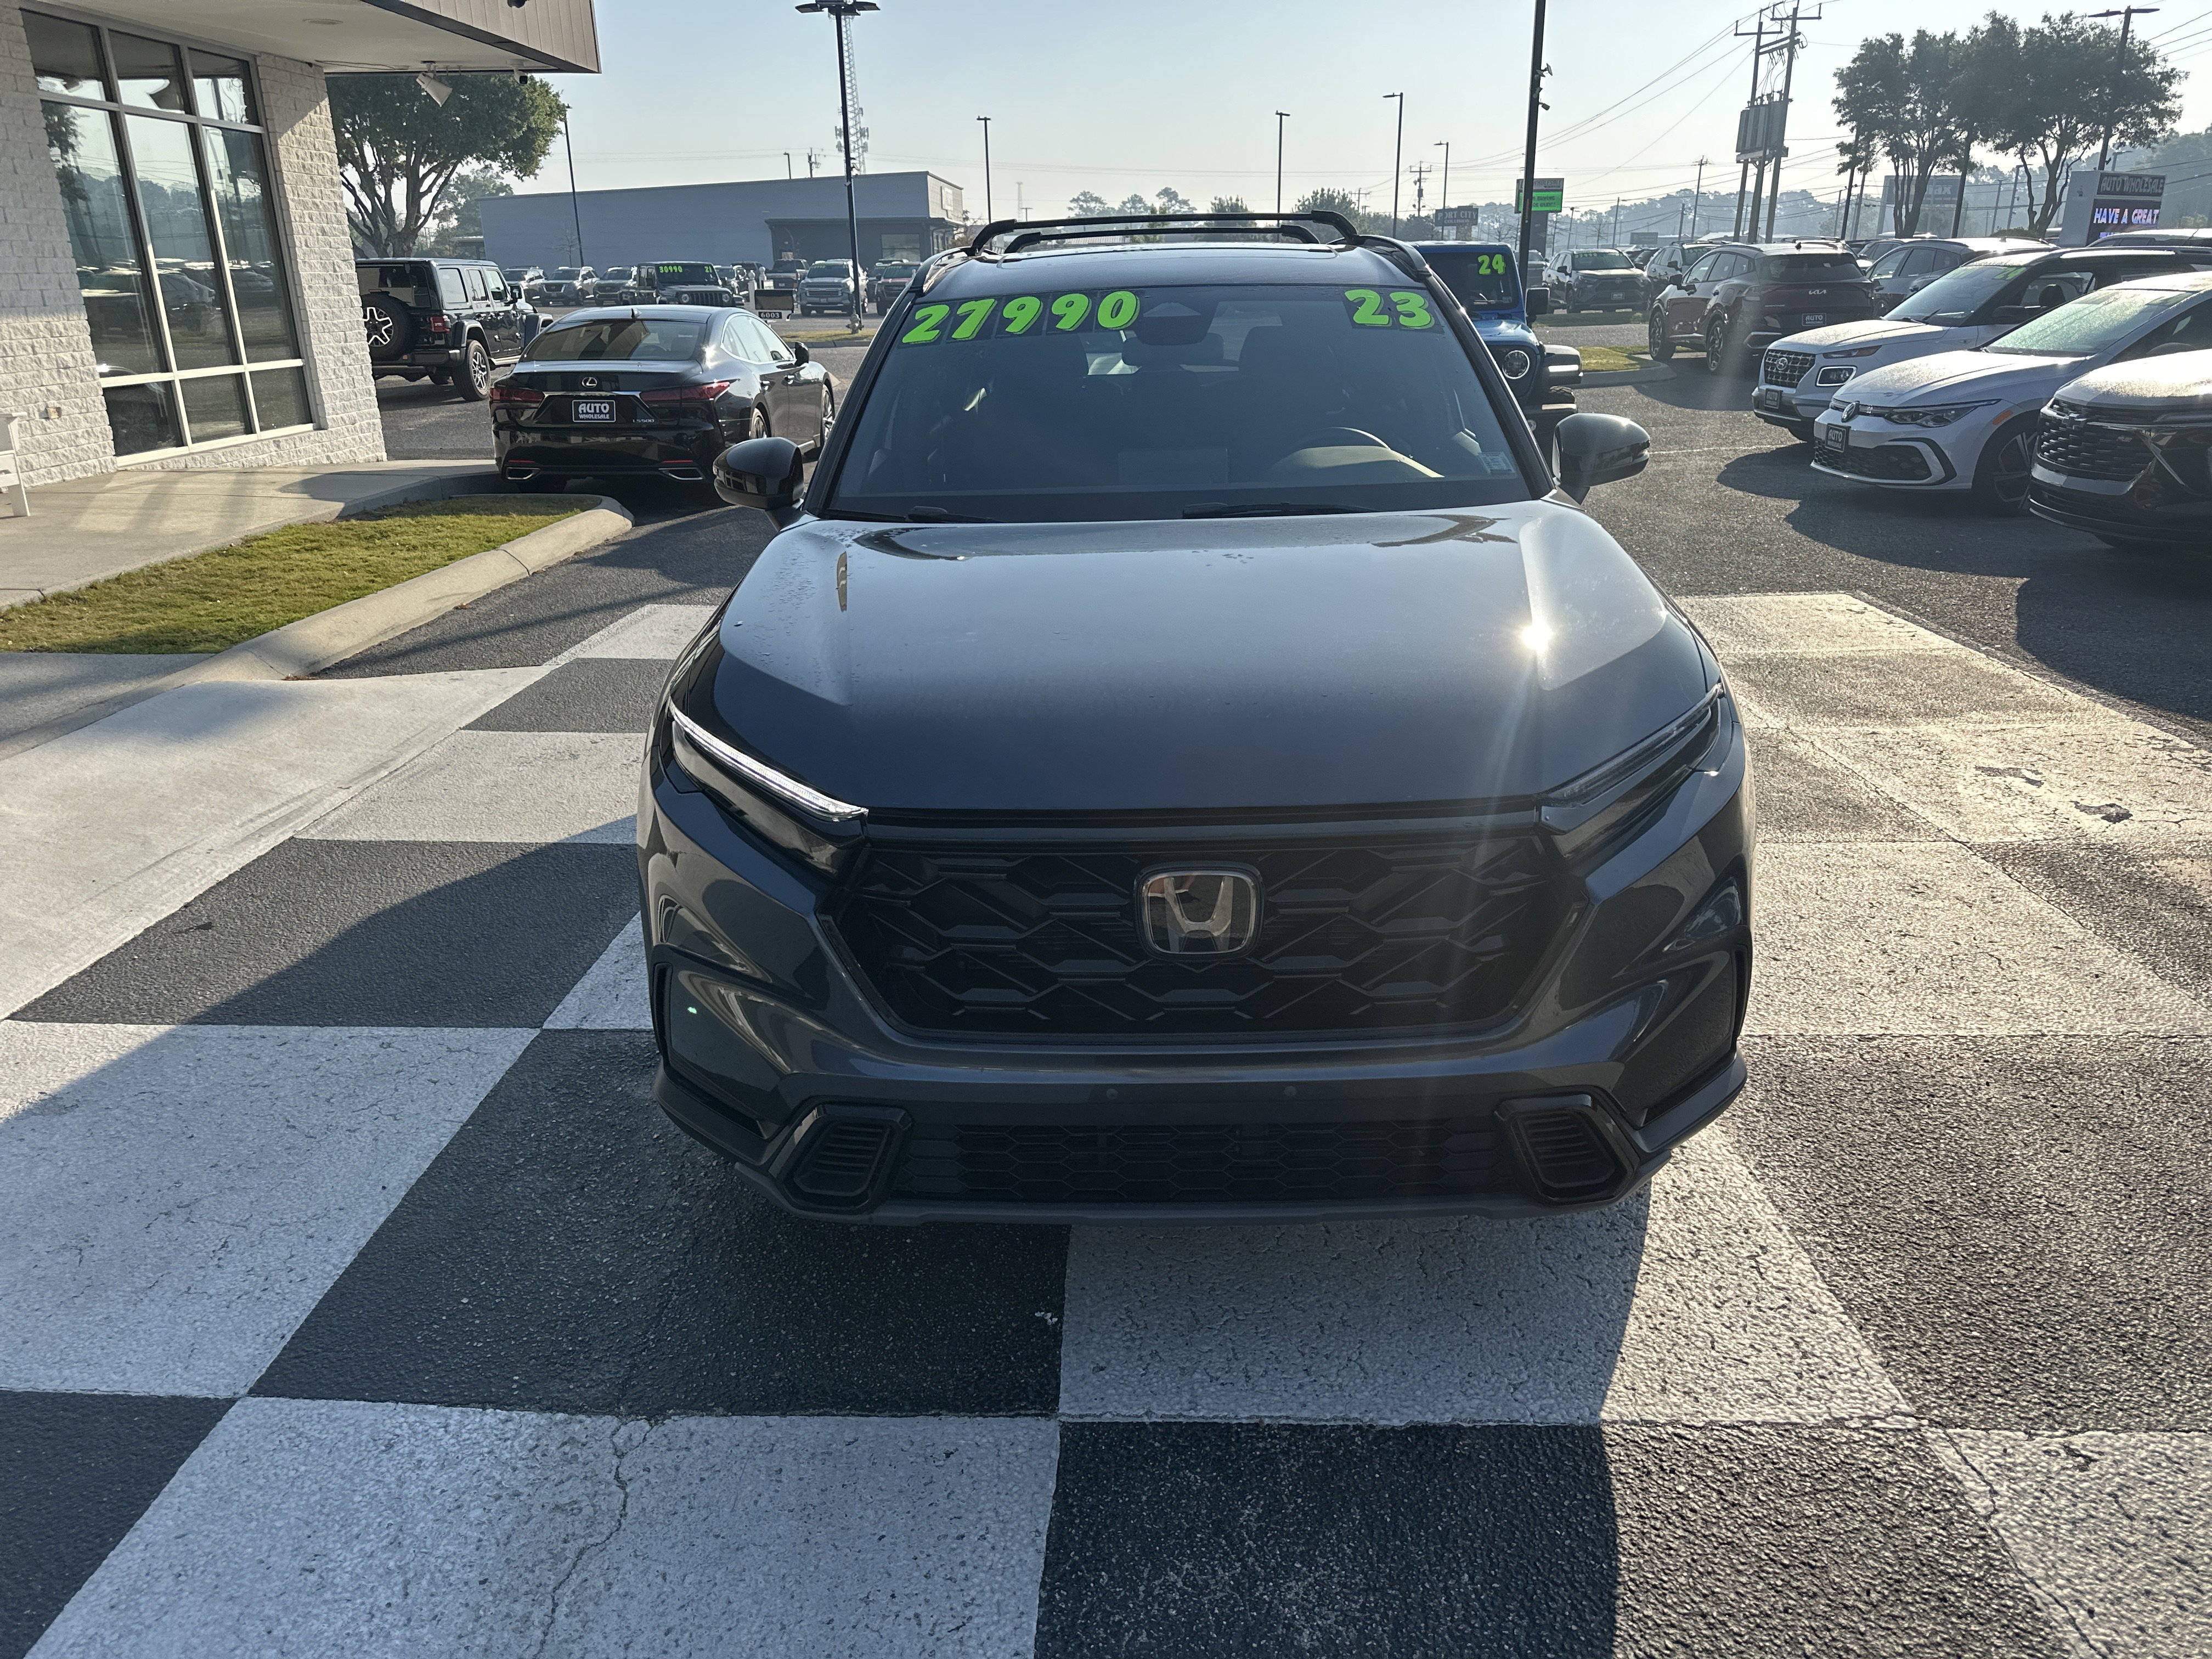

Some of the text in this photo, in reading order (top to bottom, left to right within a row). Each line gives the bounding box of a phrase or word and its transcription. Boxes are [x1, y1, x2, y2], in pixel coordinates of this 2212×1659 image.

[2101, 176, 2164, 193] AUTO WHOLESALE
[1460, 211, 1477, 219] CITY
[2094, 208, 2159, 224] HAVE A GREAT
[1477, 254, 1505, 275] 24
[902, 289, 1435, 344] 27990 23
[1767, 391, 1778, 400] AUTO
[578, 403, 610, 413] AUTO
[1828, 430, 1843, 442] AUTO
